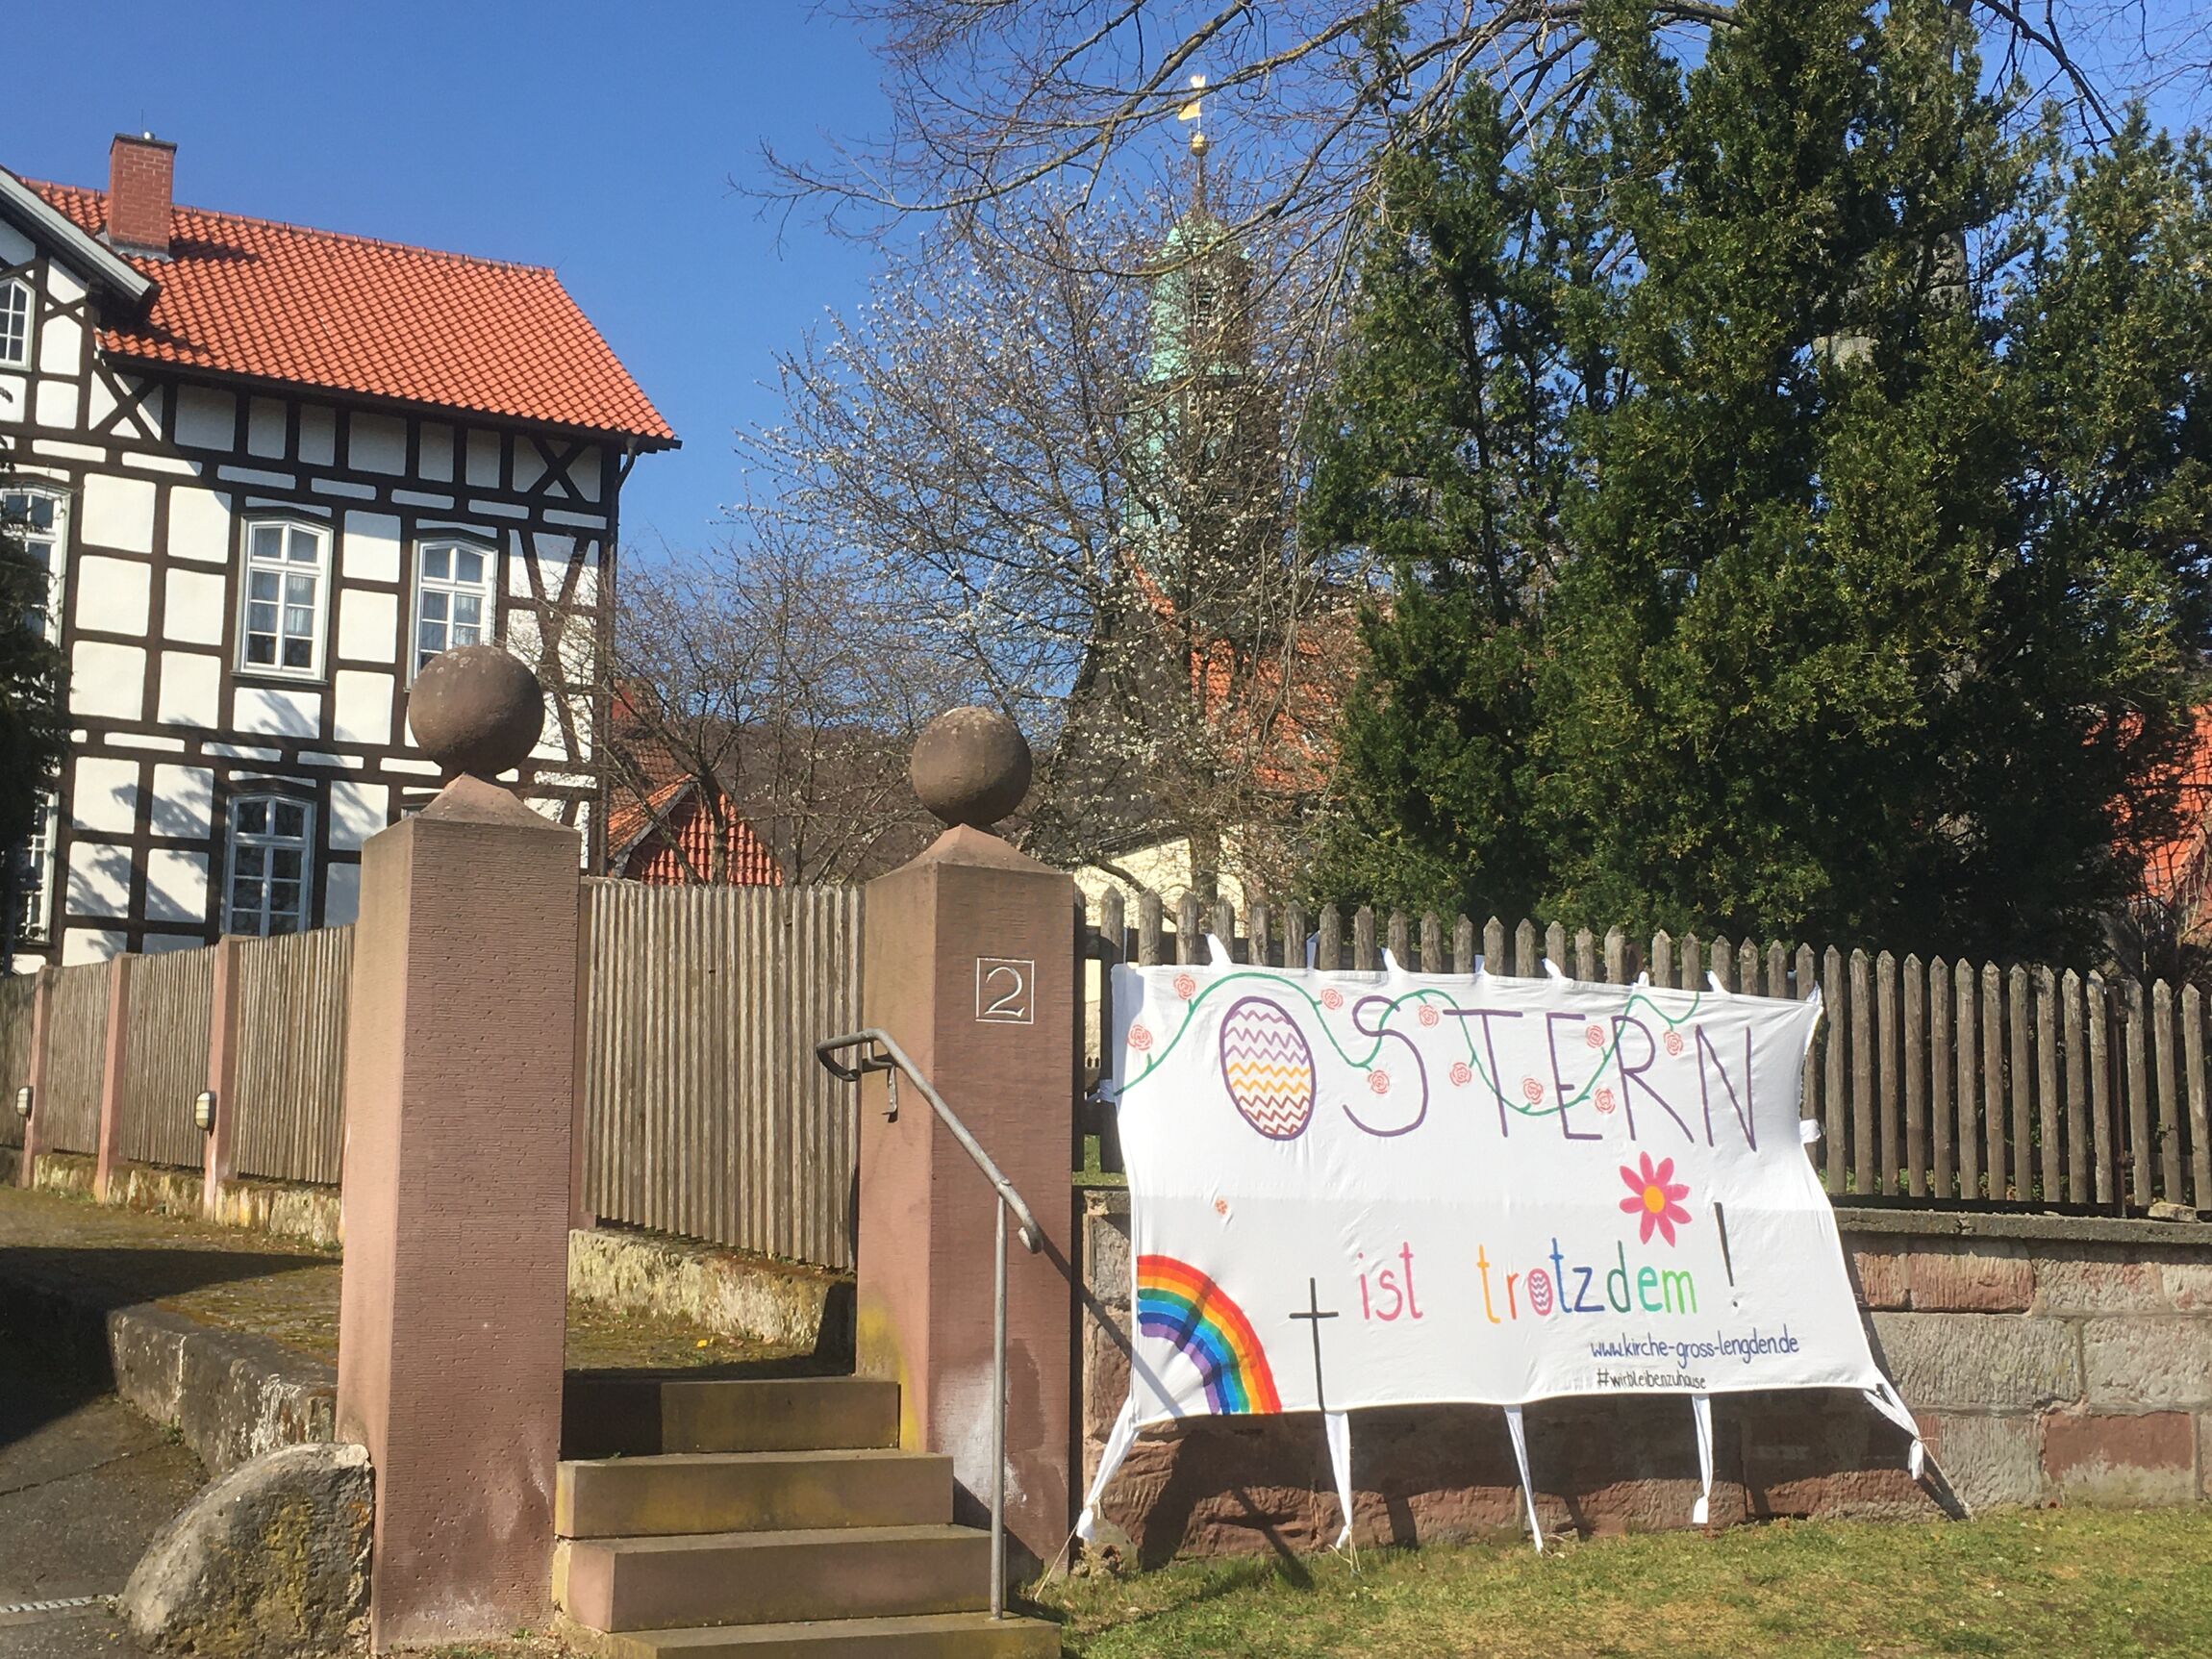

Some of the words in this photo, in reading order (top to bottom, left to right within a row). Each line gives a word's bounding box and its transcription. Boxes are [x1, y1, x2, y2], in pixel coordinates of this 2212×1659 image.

[984, 966, 1025, 1018] 2
[1219, 995, 1756, 1151] OSTERN
[1358, 1241, 1423, 1320] ist
[1477, 1238, 1697, 1323] trotzdem
[1590, 1324, 1800, 1369] www.kirche-gross-lengden.de
[1596, 1368, 1707, 1390] #wirbleibenzuhause
